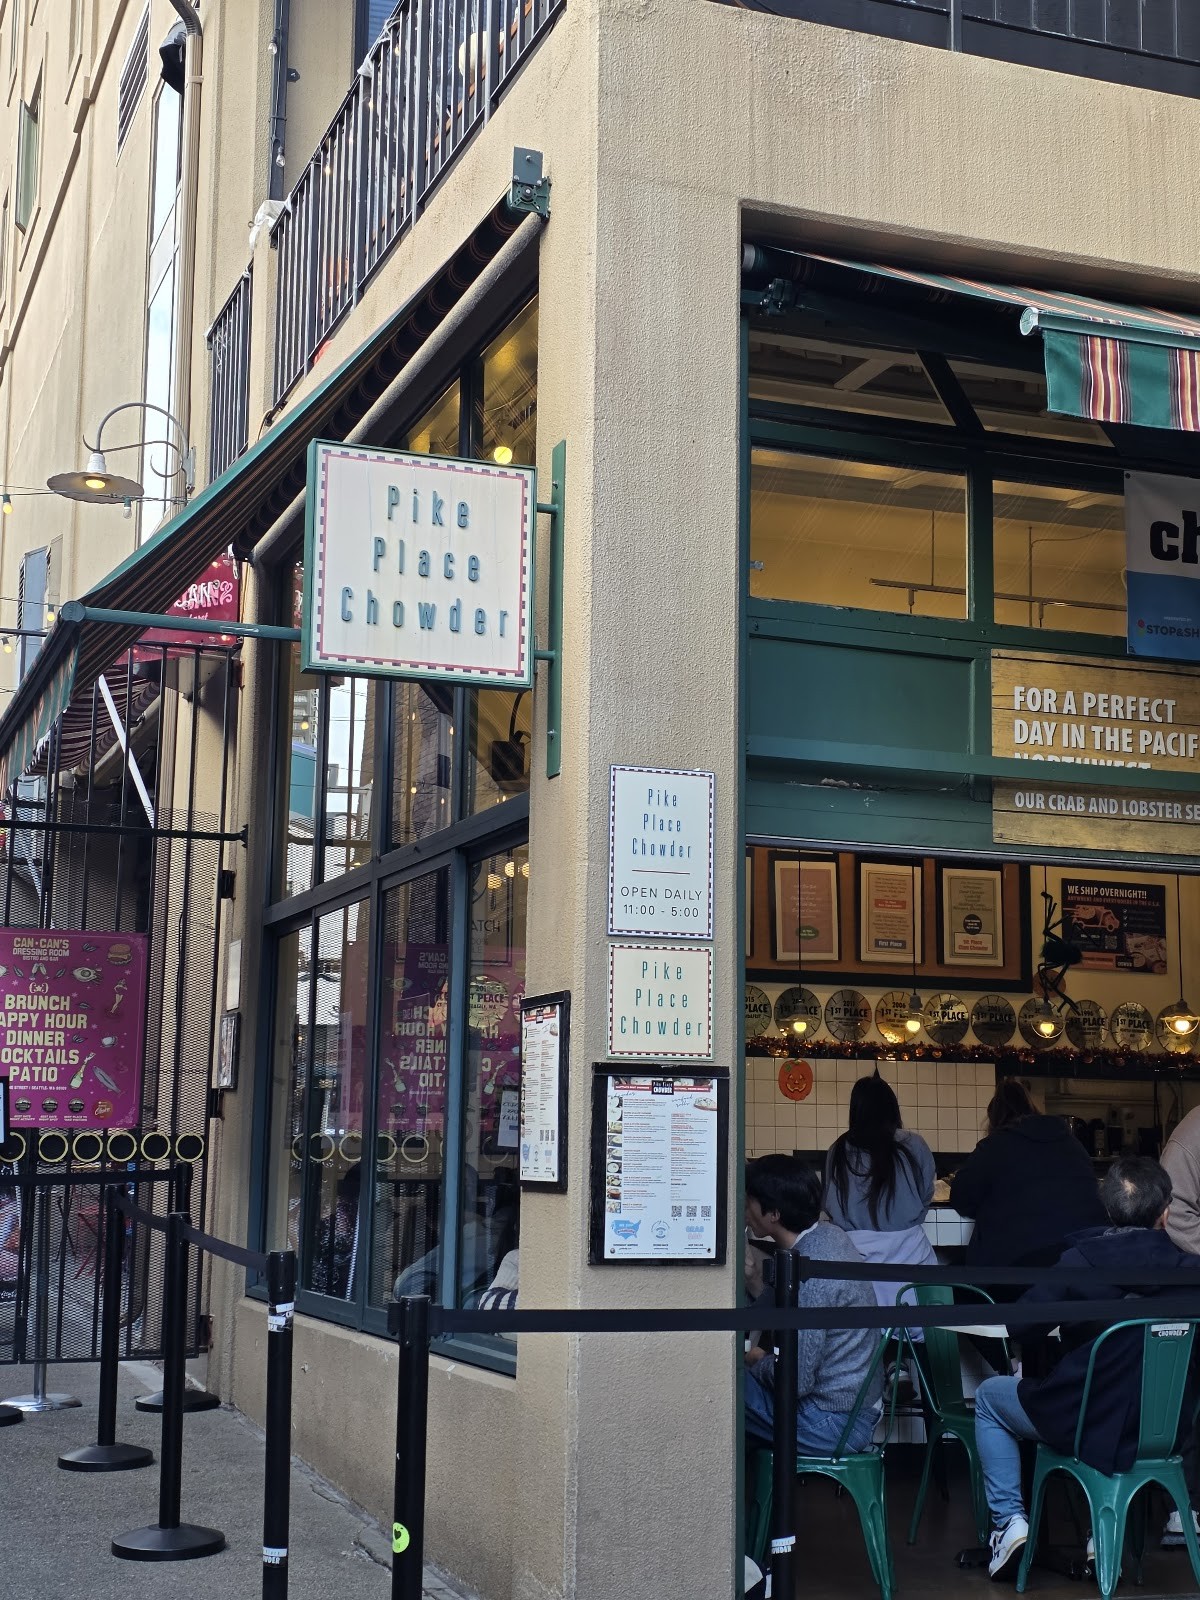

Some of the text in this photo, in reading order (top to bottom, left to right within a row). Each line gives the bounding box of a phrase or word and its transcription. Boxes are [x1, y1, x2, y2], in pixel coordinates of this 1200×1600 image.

[387, 484, 470, 528] Pike
[373, 536, 481, 582] Place
[341, 586, 509, 637] Chowder
[1014, 686, 1176, 723] FOR A PERFECT
[1014, 719, 1199, 758] DAY IN THE PACIF
[648, 788, 677, 807] Pike
[1014, 791, 1045, 809] OUR
[1048, 794, 1086, 812] CRAB
[1089, 797, 1119, 815] AND
[1122, 799, 1182, 819] LOBSTER
[643, 813, 681, 832] Place
[632, 837, 692, 858] Chowder
[620, 886, 702, 901] OPEN DAILY
[1067, 885, 1147, 899] WE SHIP OVERNIGHT!!
[623, 904, 655, 916] 11:00
[671, 906, 699, 918] 5:00
[13, 937, 70, 949] CAN CAN'S
[12, 948, 70, 957] DRESSING ROOM
[642, 961, 682, 980] Pike
[4, 994, 71, 1011] BRUNCH
[635, 988, 688, 1008] Place
[0, 1012, 88, 1029] APPY HOUR
[830, 1007, 868, 1018] 1ST PLACE
[881, 1008, 891, 1017] 1ST
[941, 1011, 965, 1021] PLACE
[988, 1013, 1012, 1022] PLACE
[620, 1015, 702, 1036] Chowder
[1082, 1017, 1105, 1027] PLACE
[1116, 1018, 1151, 1030] 1ST PLACE
[6, 1030, 65, 1047] DINNER
[0, 1048, 80, 1065] OCKTAILS
[9, 1066, 58, 1082] PATIO
